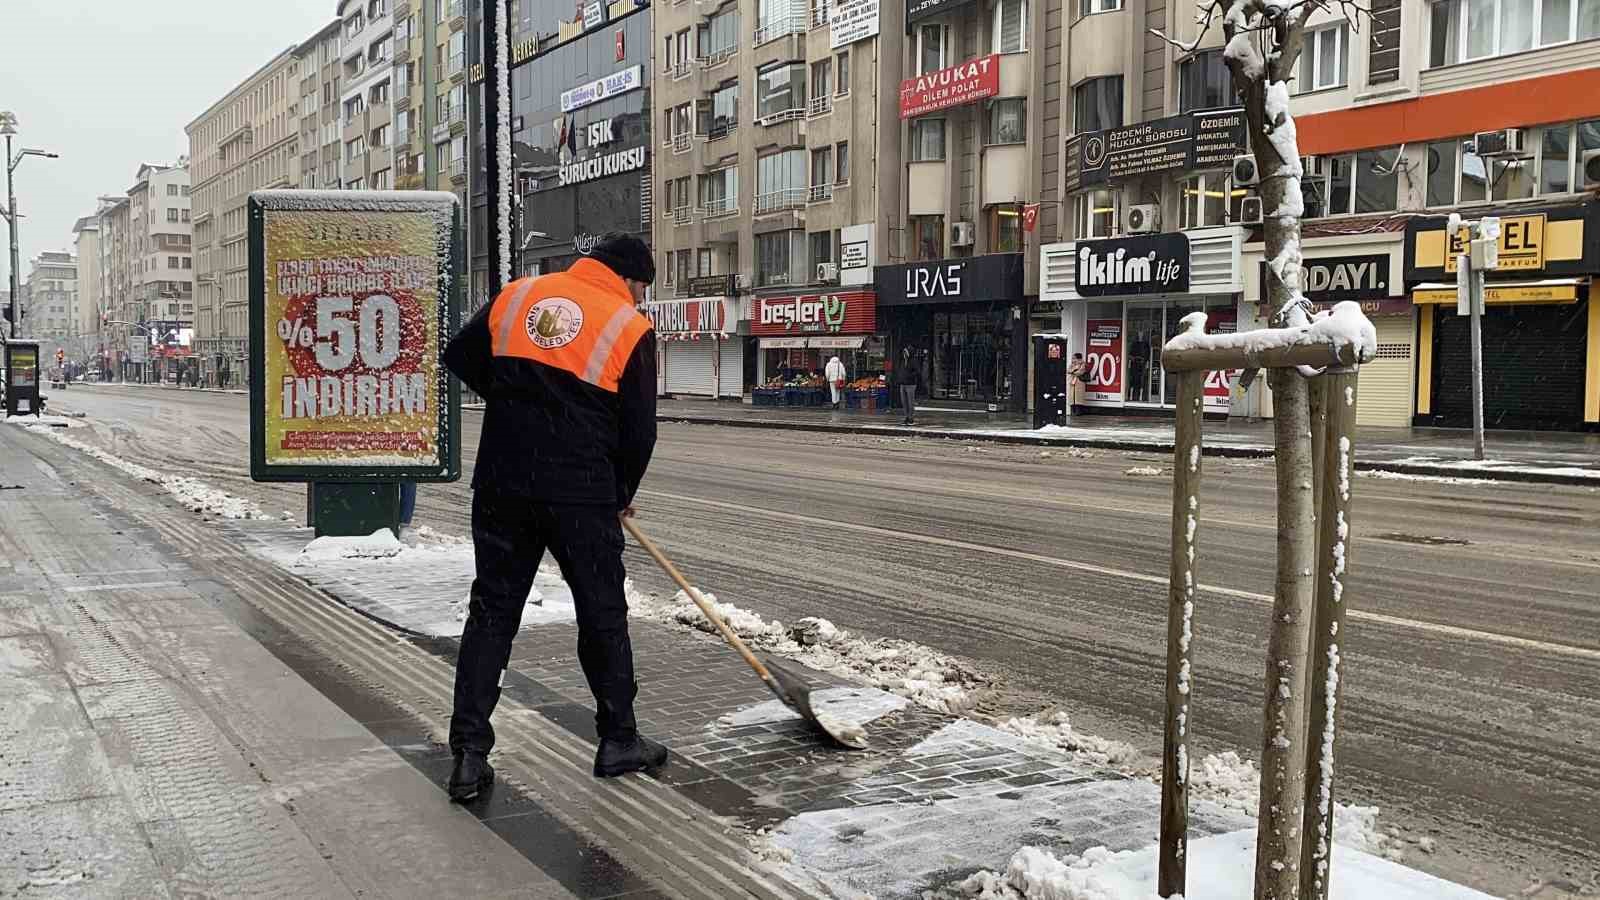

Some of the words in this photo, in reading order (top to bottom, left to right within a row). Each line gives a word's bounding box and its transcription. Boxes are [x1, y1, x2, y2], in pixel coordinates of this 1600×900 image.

[916, 60, 990, 92] AVUKAT
[923, 87, 948, 103] DİLEM
[952, 79, 980, 95] POLAT
[587, 119, 613, 148] IŞIK
[1110, 126, 1152, 141] ÖZDEMİR
[1197, 132, 1230, 140] AVUKATLIK
[1201, 115, 1240, 128] ÖZDEMİR
[1110, 137, 1142, 149] HUKUK
[1145, 128, 1187, 142] BÜROSU
[559, 152, 602, 186] SÜRÜCÜ
[604, 146, 645, 176] KURSU
[906, 262, 961, 298] URAS
[1156, 258, 1180, 285] life
[698, 300, 719, 331] AVM
[761, 296, 823, 330] beşler
[278, 294, 400, 371] %50
[282, 373, 426, 419] İNDİRİM
